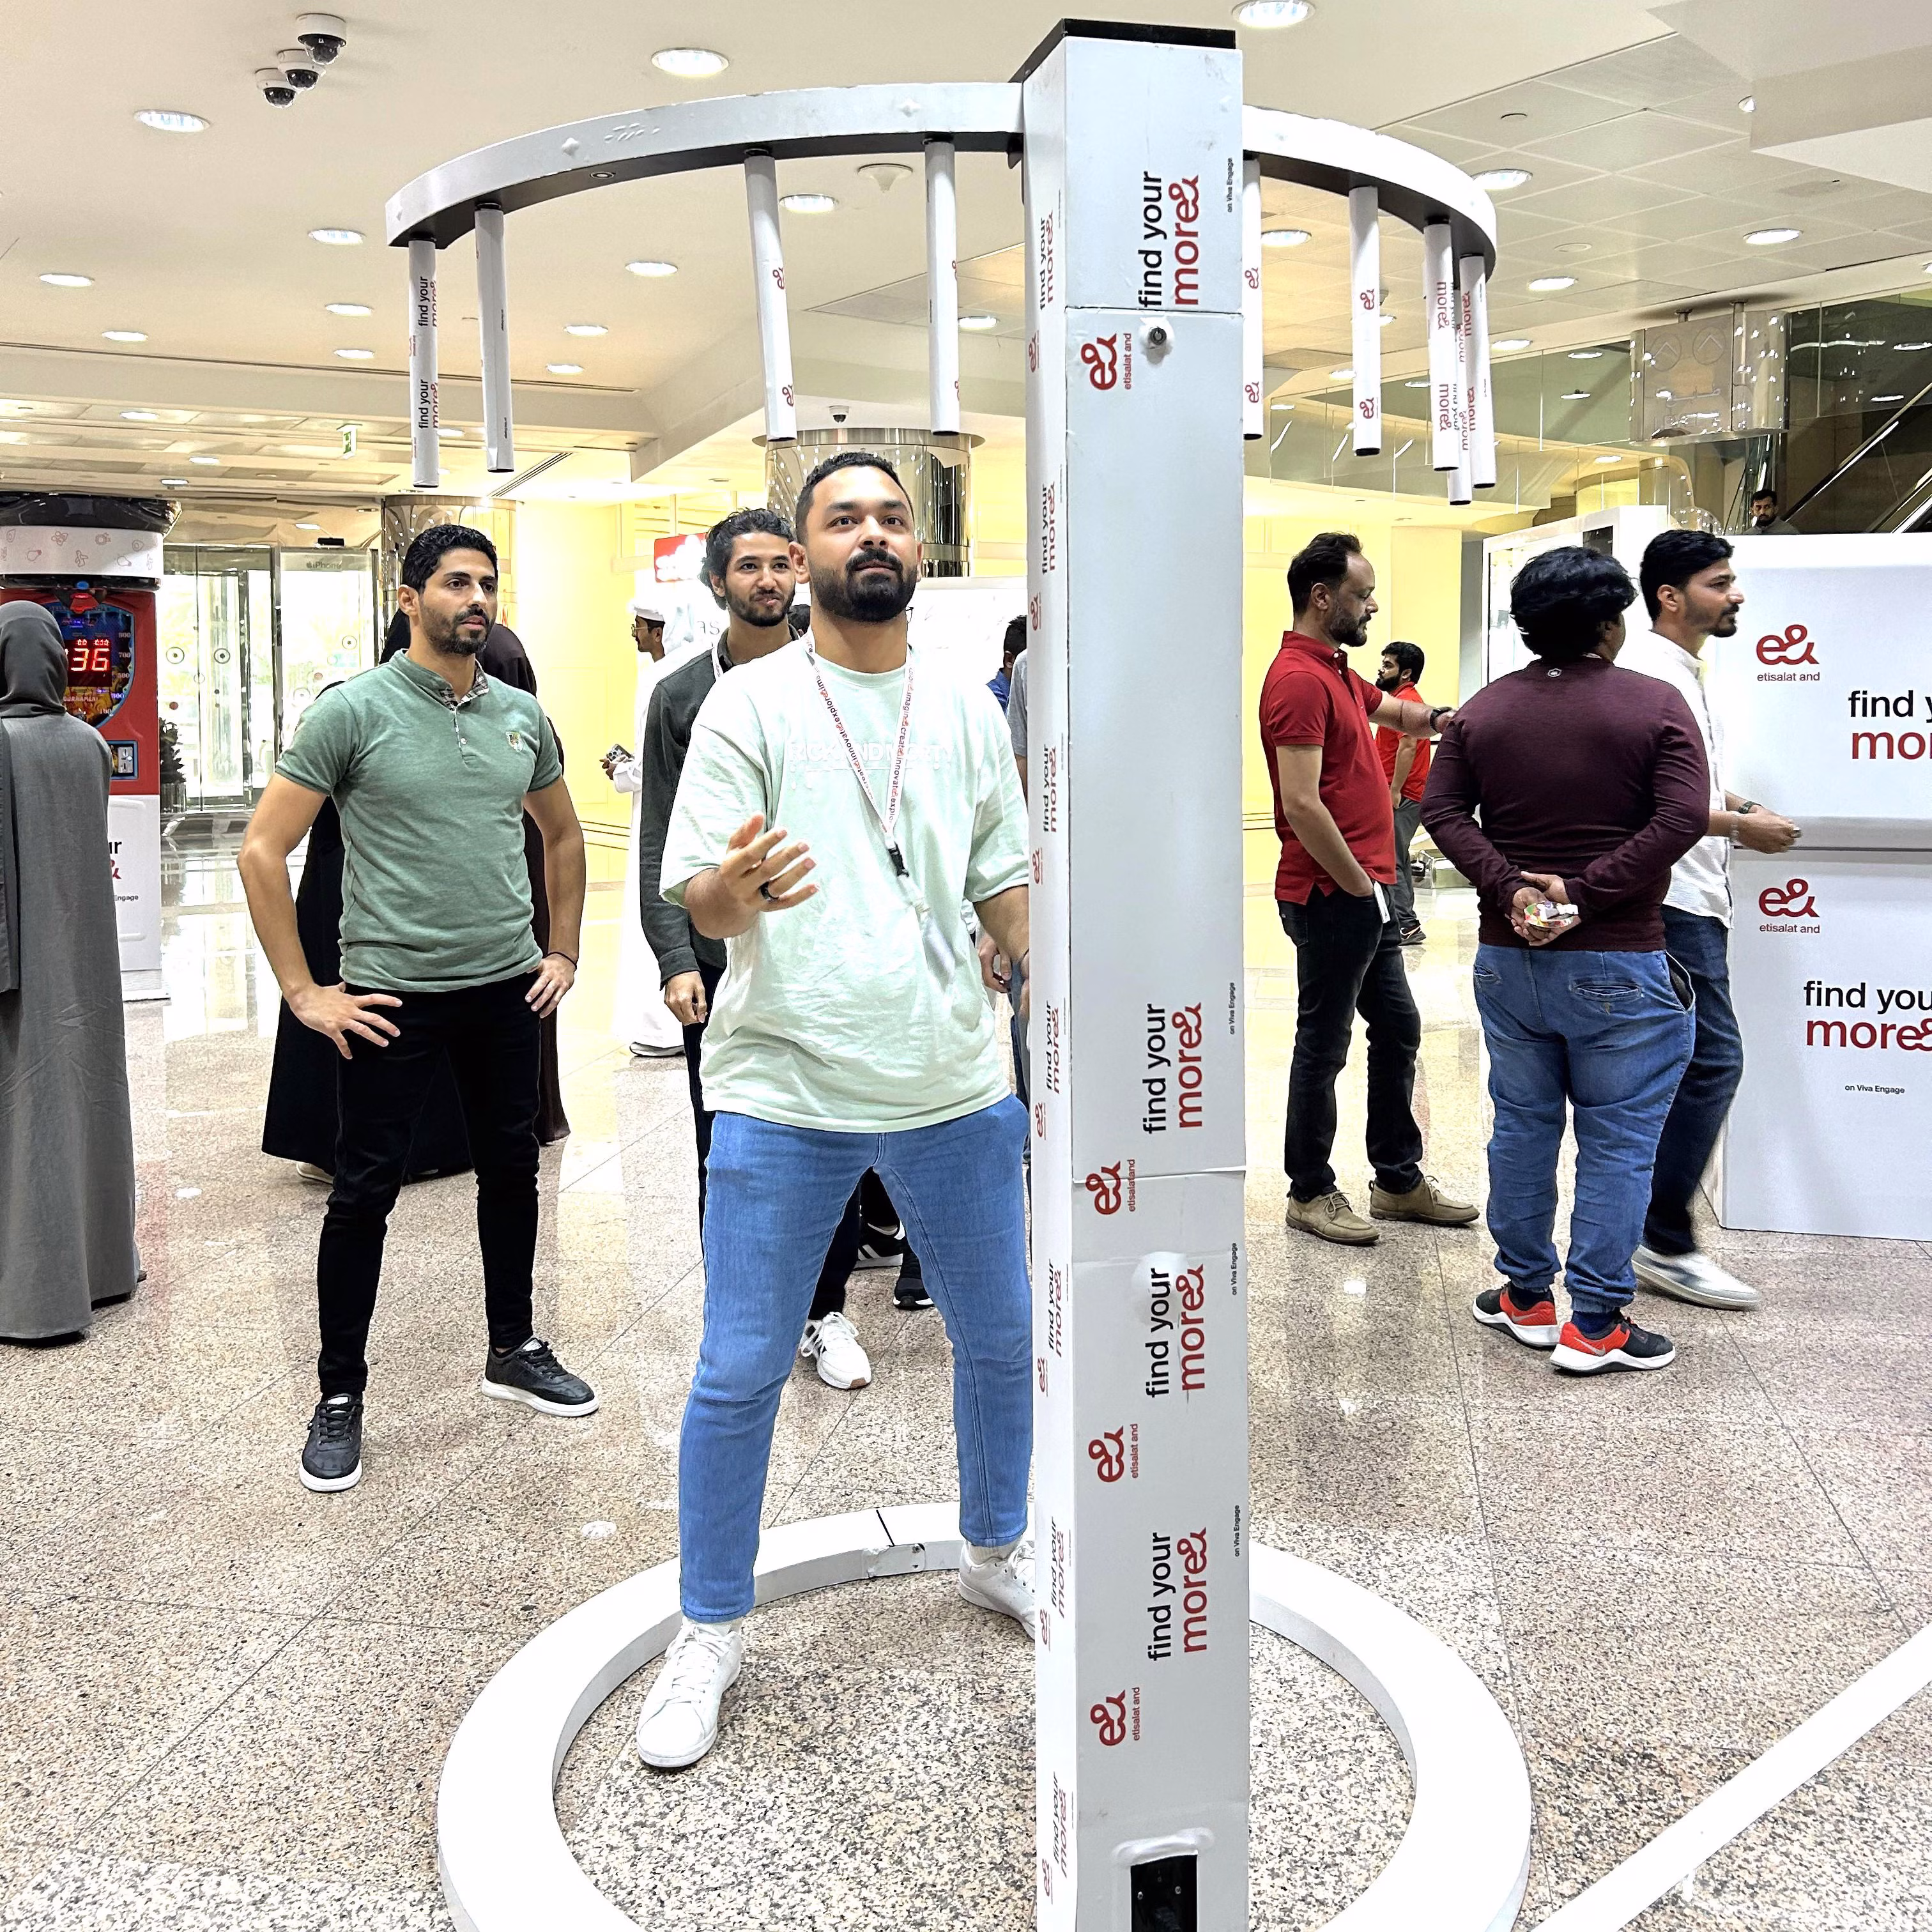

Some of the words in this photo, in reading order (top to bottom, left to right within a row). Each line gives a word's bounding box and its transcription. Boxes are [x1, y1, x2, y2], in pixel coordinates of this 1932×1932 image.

[1144, 171, 1167, 240] your
[1169, 175, 1199, 305] more&
[420, 277, 431, 304] your
[1138, 250, 1163, 307] find
[418, 305, 429, 326] find
[1123, 333, 1131, 352] and
[420, 379, 431, 406] your
[1123, 354, 1131, 390] etisalat
[418, 407, 429, 429] find
[1439, 384, 1452, 432] more&
[65, 648, 110, 671] 36
[1757, 672, 1797, 682] etisalat
[1799, 671, 1820, 682] and
[1848, 690, 1913, 717] find
[1759, 923, 1798, 933] etisalat
[1800, 924, 1820, 933] and
[1804, 981, 1866, 1008] find
[1876, 989, 1932, 1015] you
[1147, 1004, 1170, 1069] your
[1172, 1002, 1202, 1128] more&
[1857, 1084, 1873, 1092] Viva
[1874, 1085, 1905, 1094] Engage
[1142, 1078, 1166, 1134] find
[1150, 1268, 1174, 1332] your
[1176, 1264, 1205, 1391] more&
[1145, 1341, 1169, 1398] find
[1153, 1532, 1176, 1597] your
[1177, 1527, 1207, 1653] more&
[1147, 1604, 1171, 1661] find
